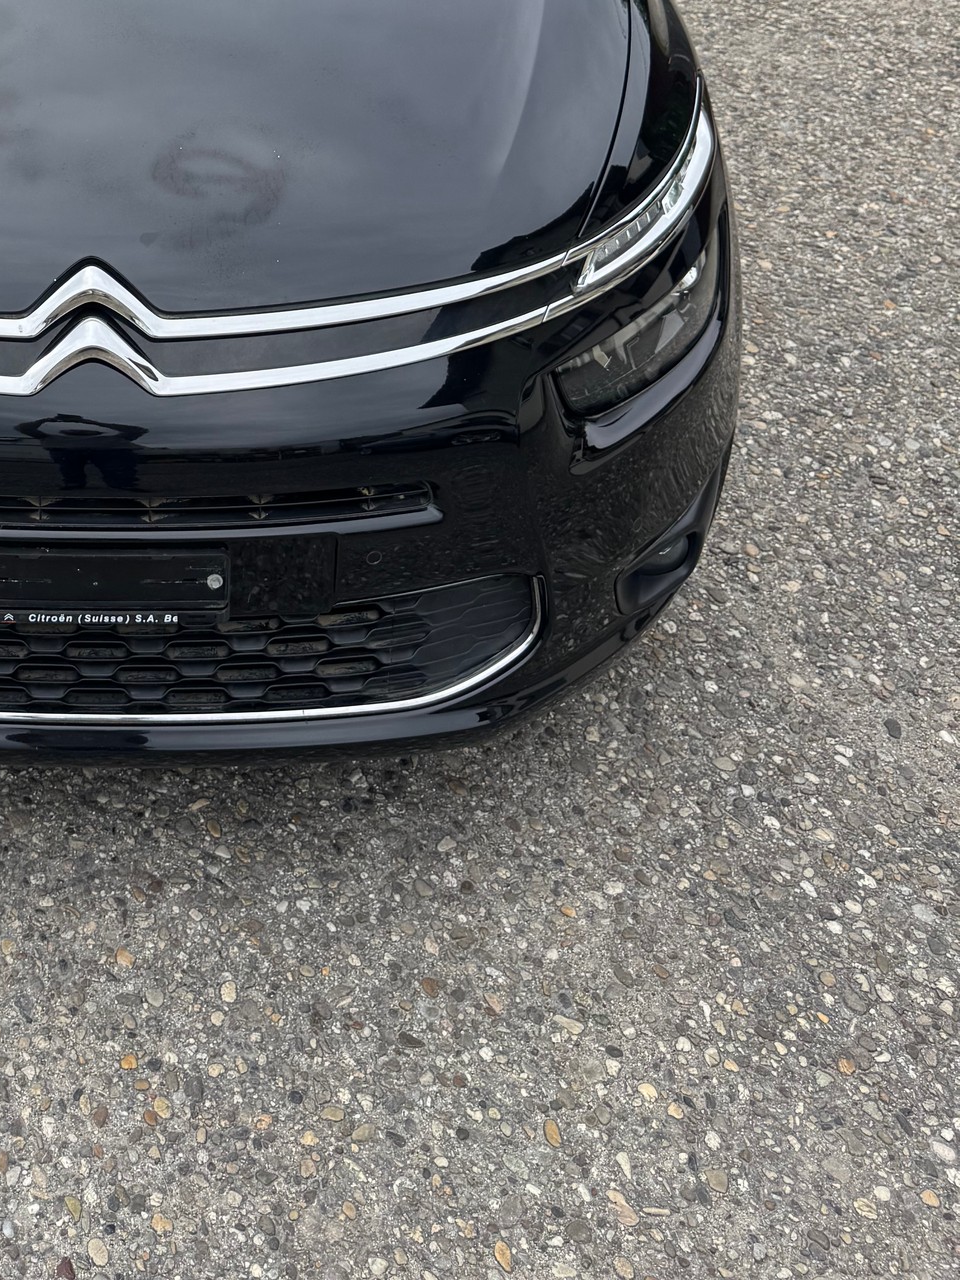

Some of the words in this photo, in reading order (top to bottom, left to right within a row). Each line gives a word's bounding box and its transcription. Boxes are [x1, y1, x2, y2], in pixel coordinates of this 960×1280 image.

[28, 613, 73, 623] Citroën
[78, 614, 130, 624] (Suisse)
[135, 614, 159, 623] S.A.
